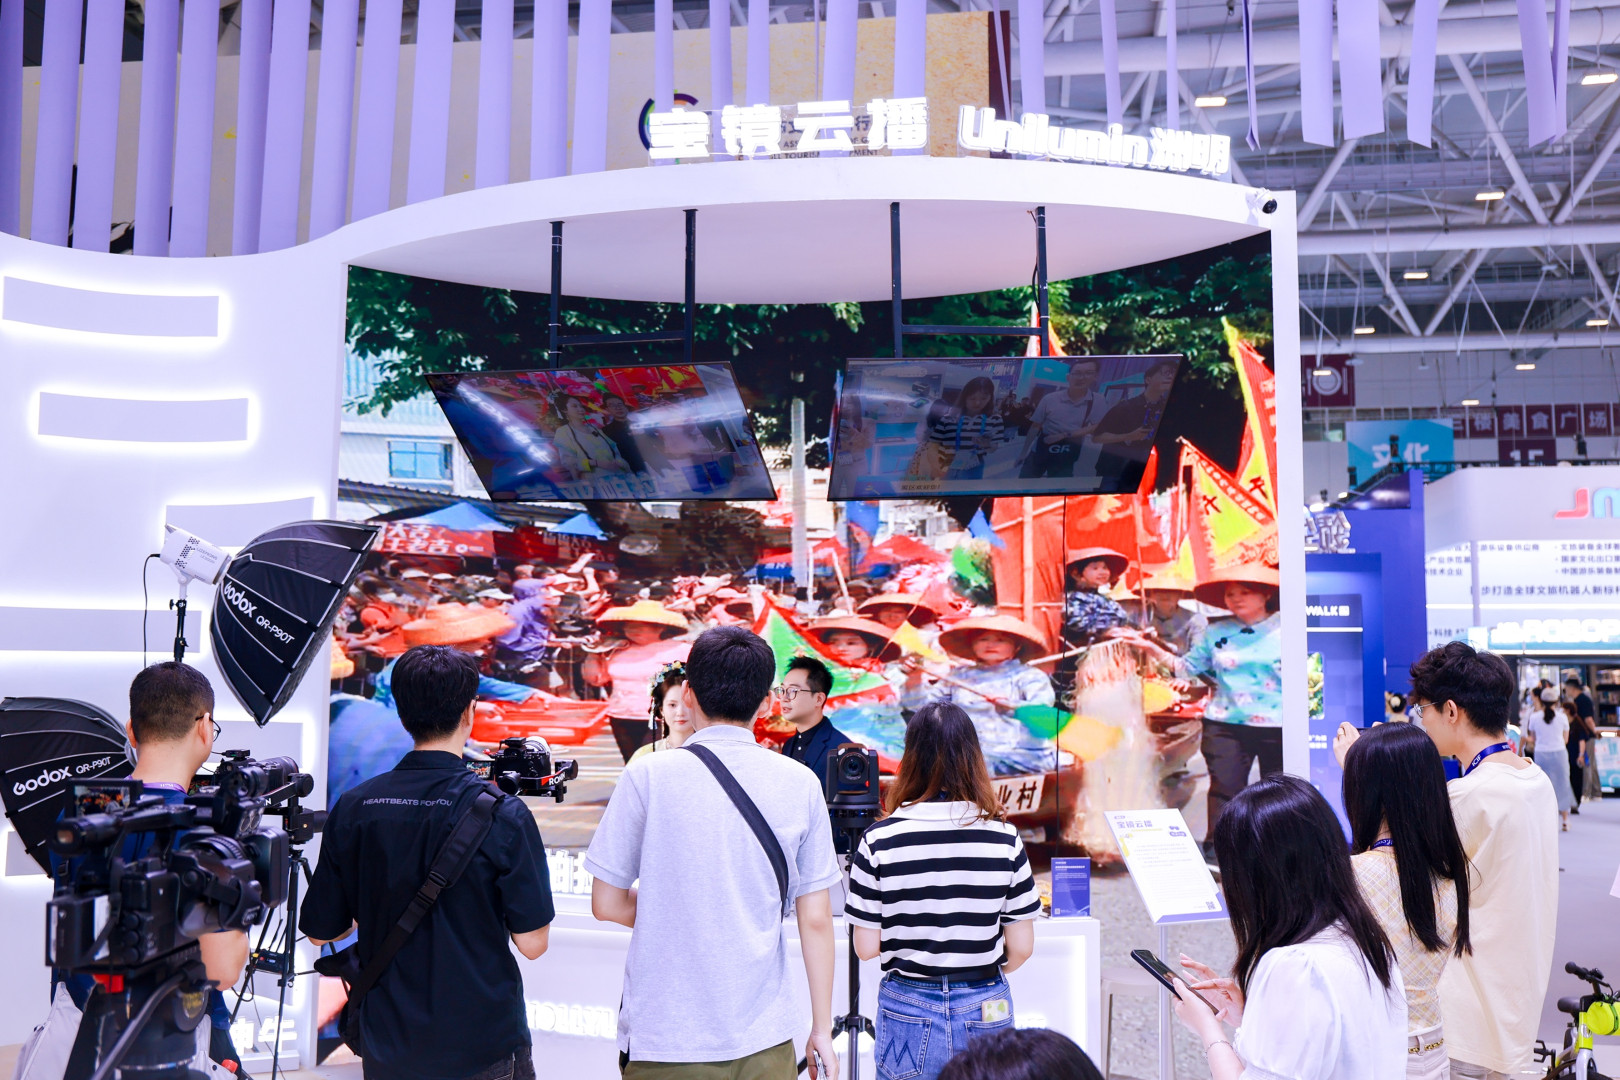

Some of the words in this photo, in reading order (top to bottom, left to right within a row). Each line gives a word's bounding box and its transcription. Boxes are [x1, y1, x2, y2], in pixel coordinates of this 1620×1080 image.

[224, 581, 257, 618] Godox
[256, 615, 295, 644] QR-P90T
[13, 766, 72, 796] Godox
[76, 756, 111, 774] QR-P90T
[363, 797, 419, 806] HEARTBEATS
